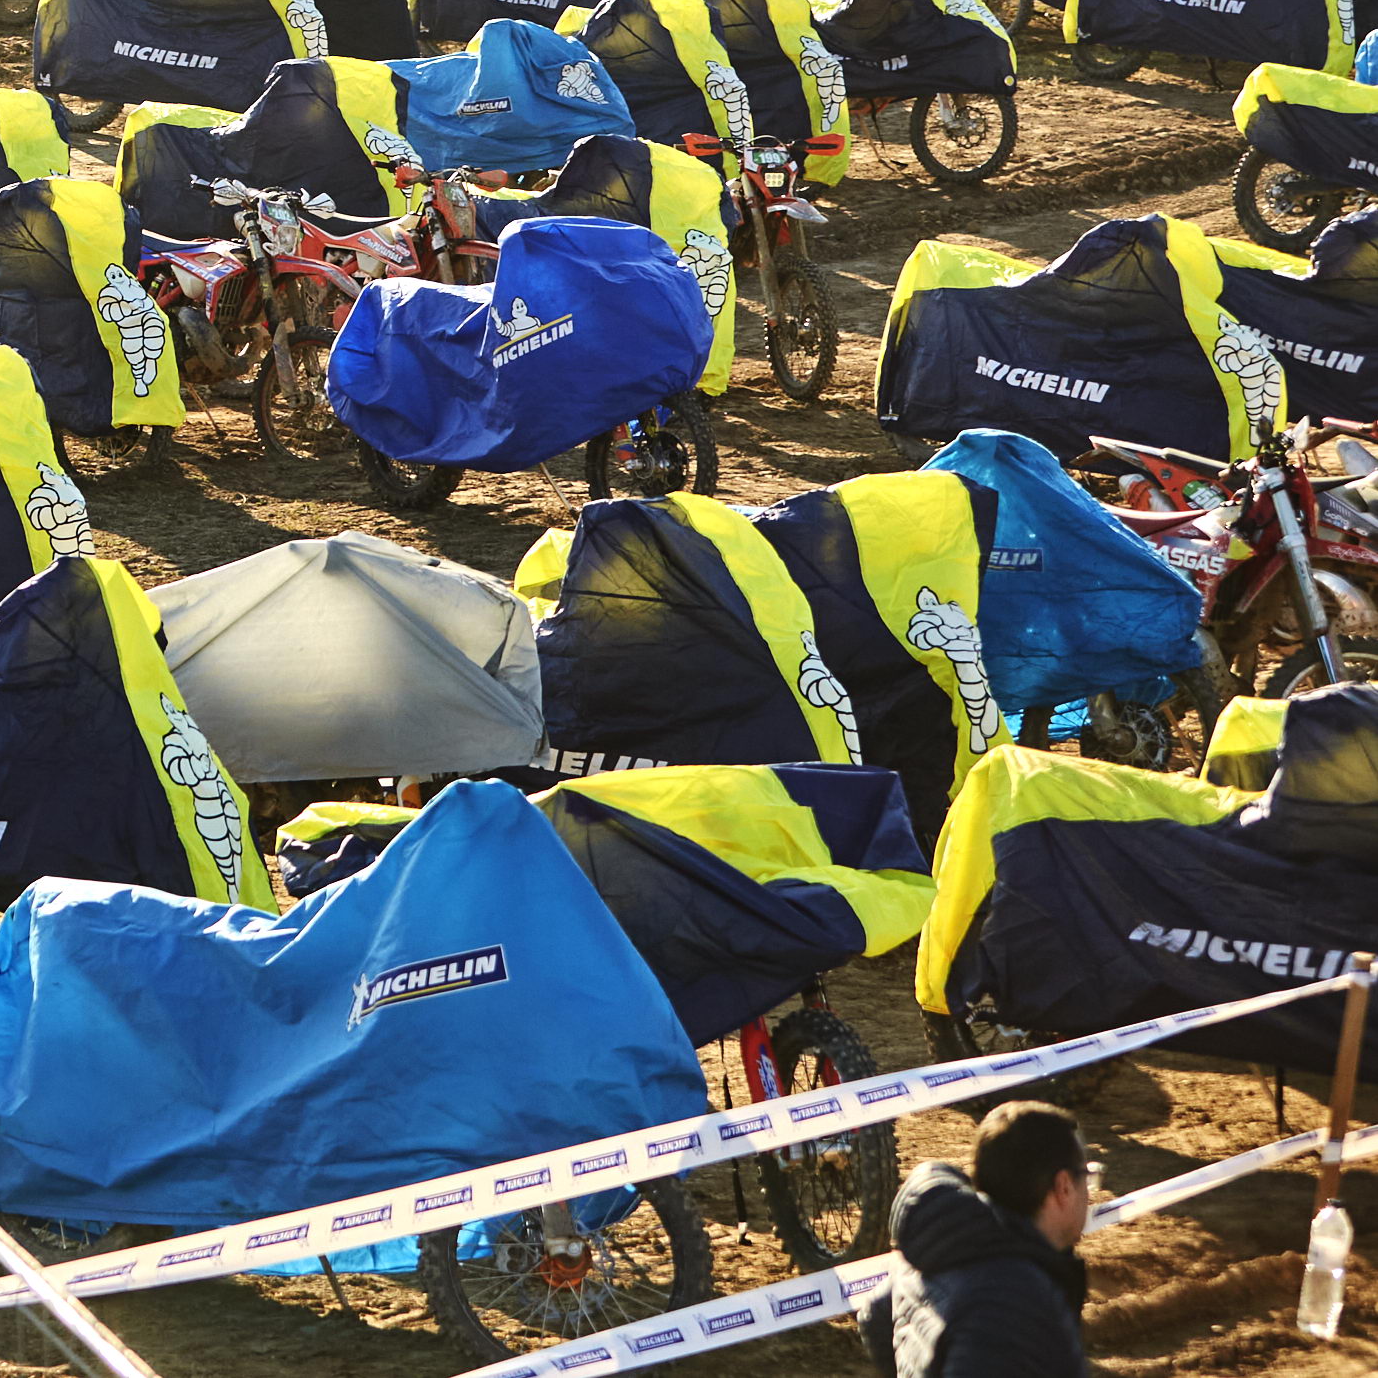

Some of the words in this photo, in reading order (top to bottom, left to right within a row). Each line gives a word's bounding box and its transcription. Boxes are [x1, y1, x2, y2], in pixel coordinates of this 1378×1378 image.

[114, 40, 219, 70] MICHELIN
[759, 152, 781, 164] 199
[492, 319, 575, 369] MICHELIN
[975, 356, 1111, 403] MICHELIN
[368, 952, 499, 1007] MICHELIN
[781, 1293, 822, 1311] MICHELIN
[710, 1311, 752, 1329] MICHELIN
[638, 1331, 680, 1349] MICHELIN
[564, 1348, 605, 1364] MICHELIN
